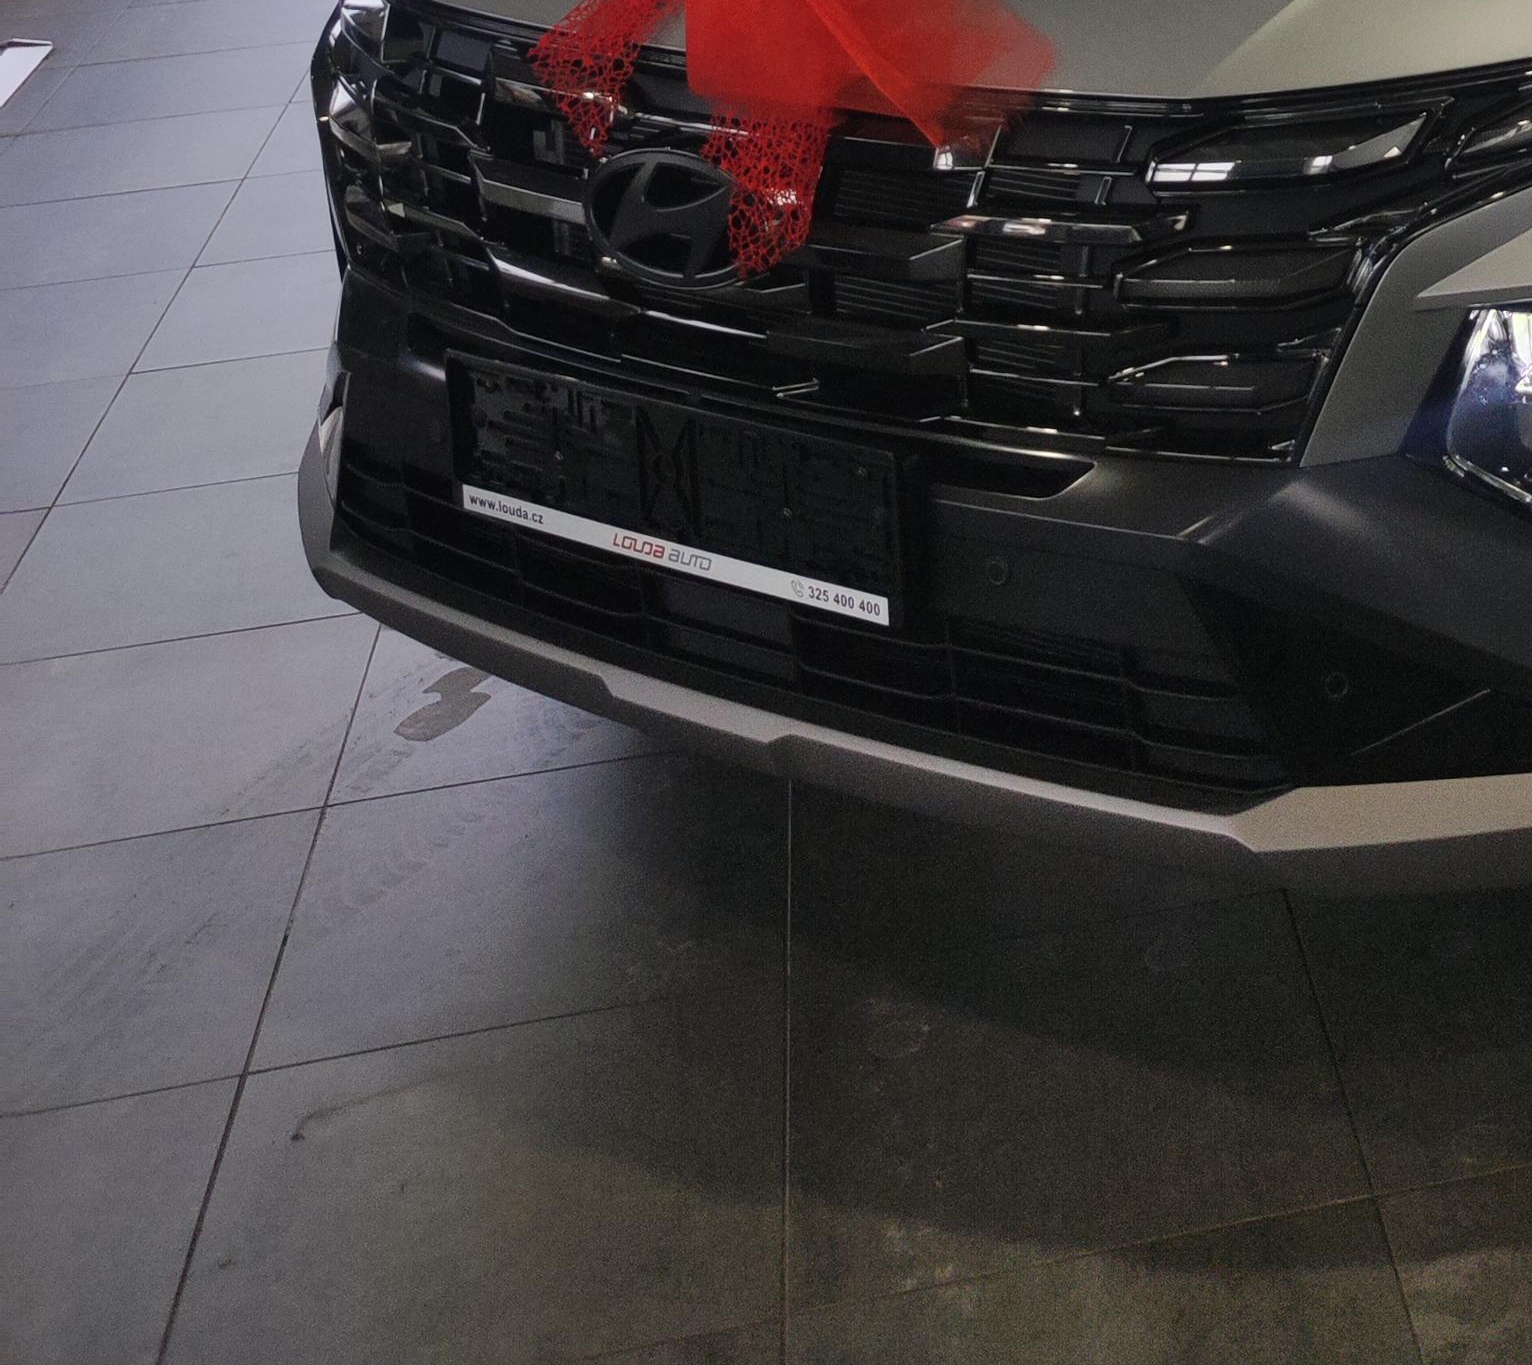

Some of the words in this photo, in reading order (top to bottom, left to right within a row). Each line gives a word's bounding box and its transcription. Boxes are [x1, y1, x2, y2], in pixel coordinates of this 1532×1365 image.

[469, 494, 544, 525] www.louda.cz
[612, 533, 666, 559] LOUDA
[668, 548, 713, 571] AUTO
[808, 585, 830, 603] 325
[833, 592, 855, 609] 400
[859, 599, 880, 616] 400
